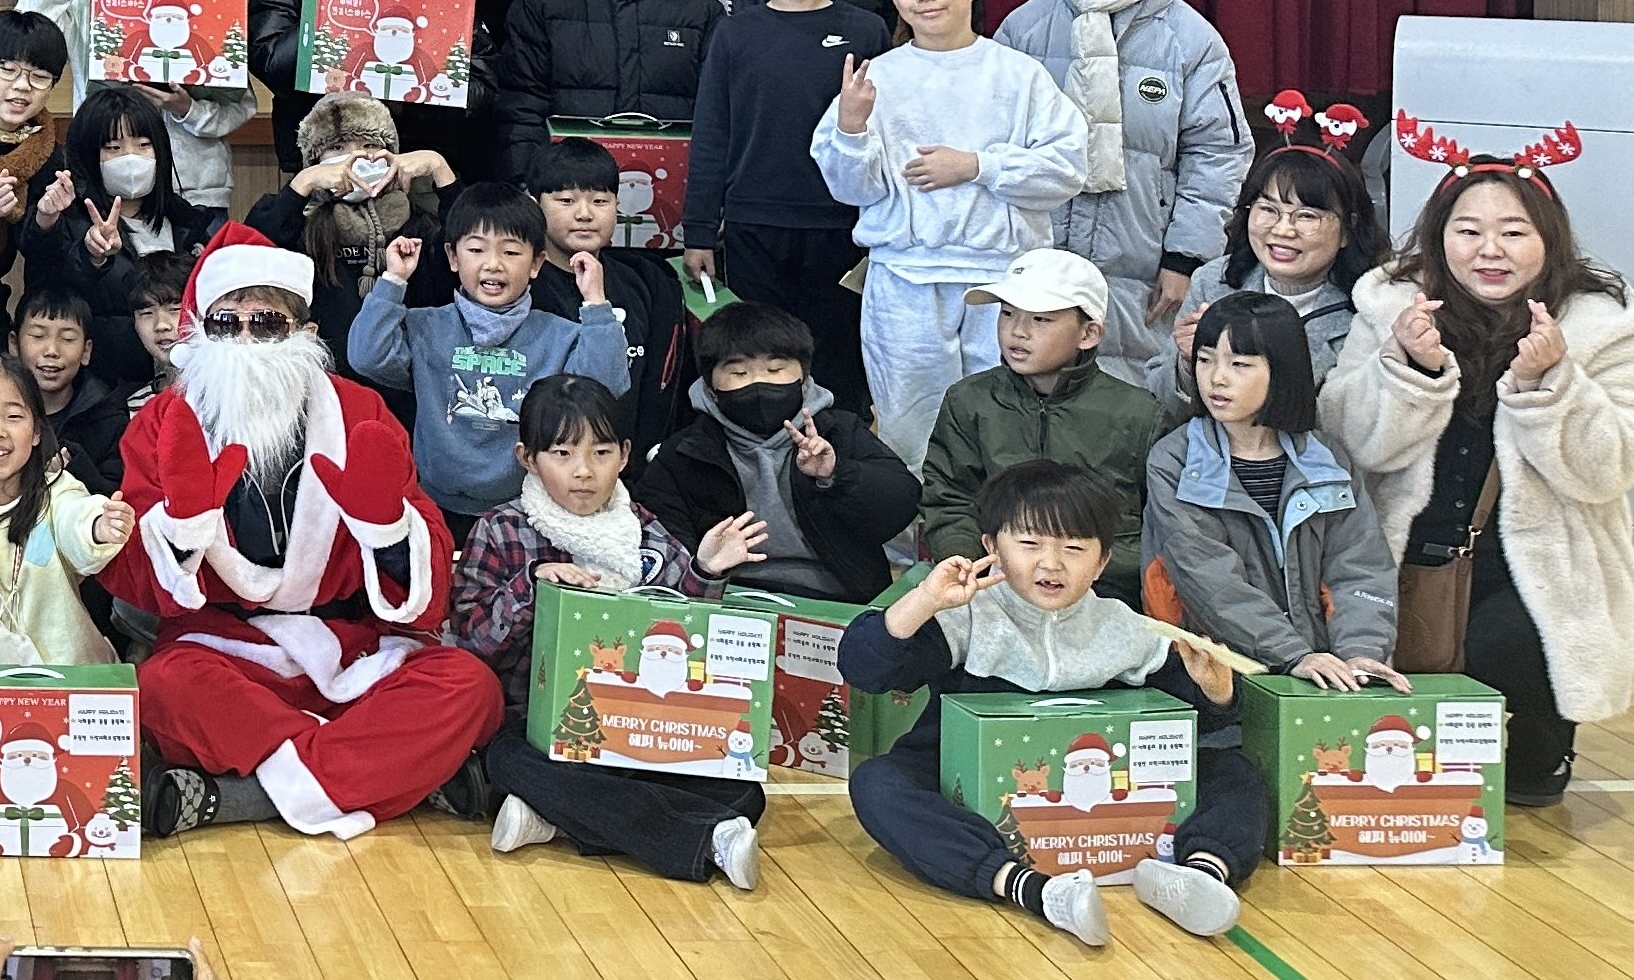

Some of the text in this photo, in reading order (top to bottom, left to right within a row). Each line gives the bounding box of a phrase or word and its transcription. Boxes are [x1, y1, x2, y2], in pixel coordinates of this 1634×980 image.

[451, 354, 527, 377] SPACE
[18, 697, 39, 706] NEW
[41, 697, 67, 706] YEAR
[602, 714, 727, 739] MERRY CHRISTMAS
[1330, 814, 1460, 828] MERRY CHRISTMAS
[1030, 832, 1154, 850] MERRY CHRISTMAS
